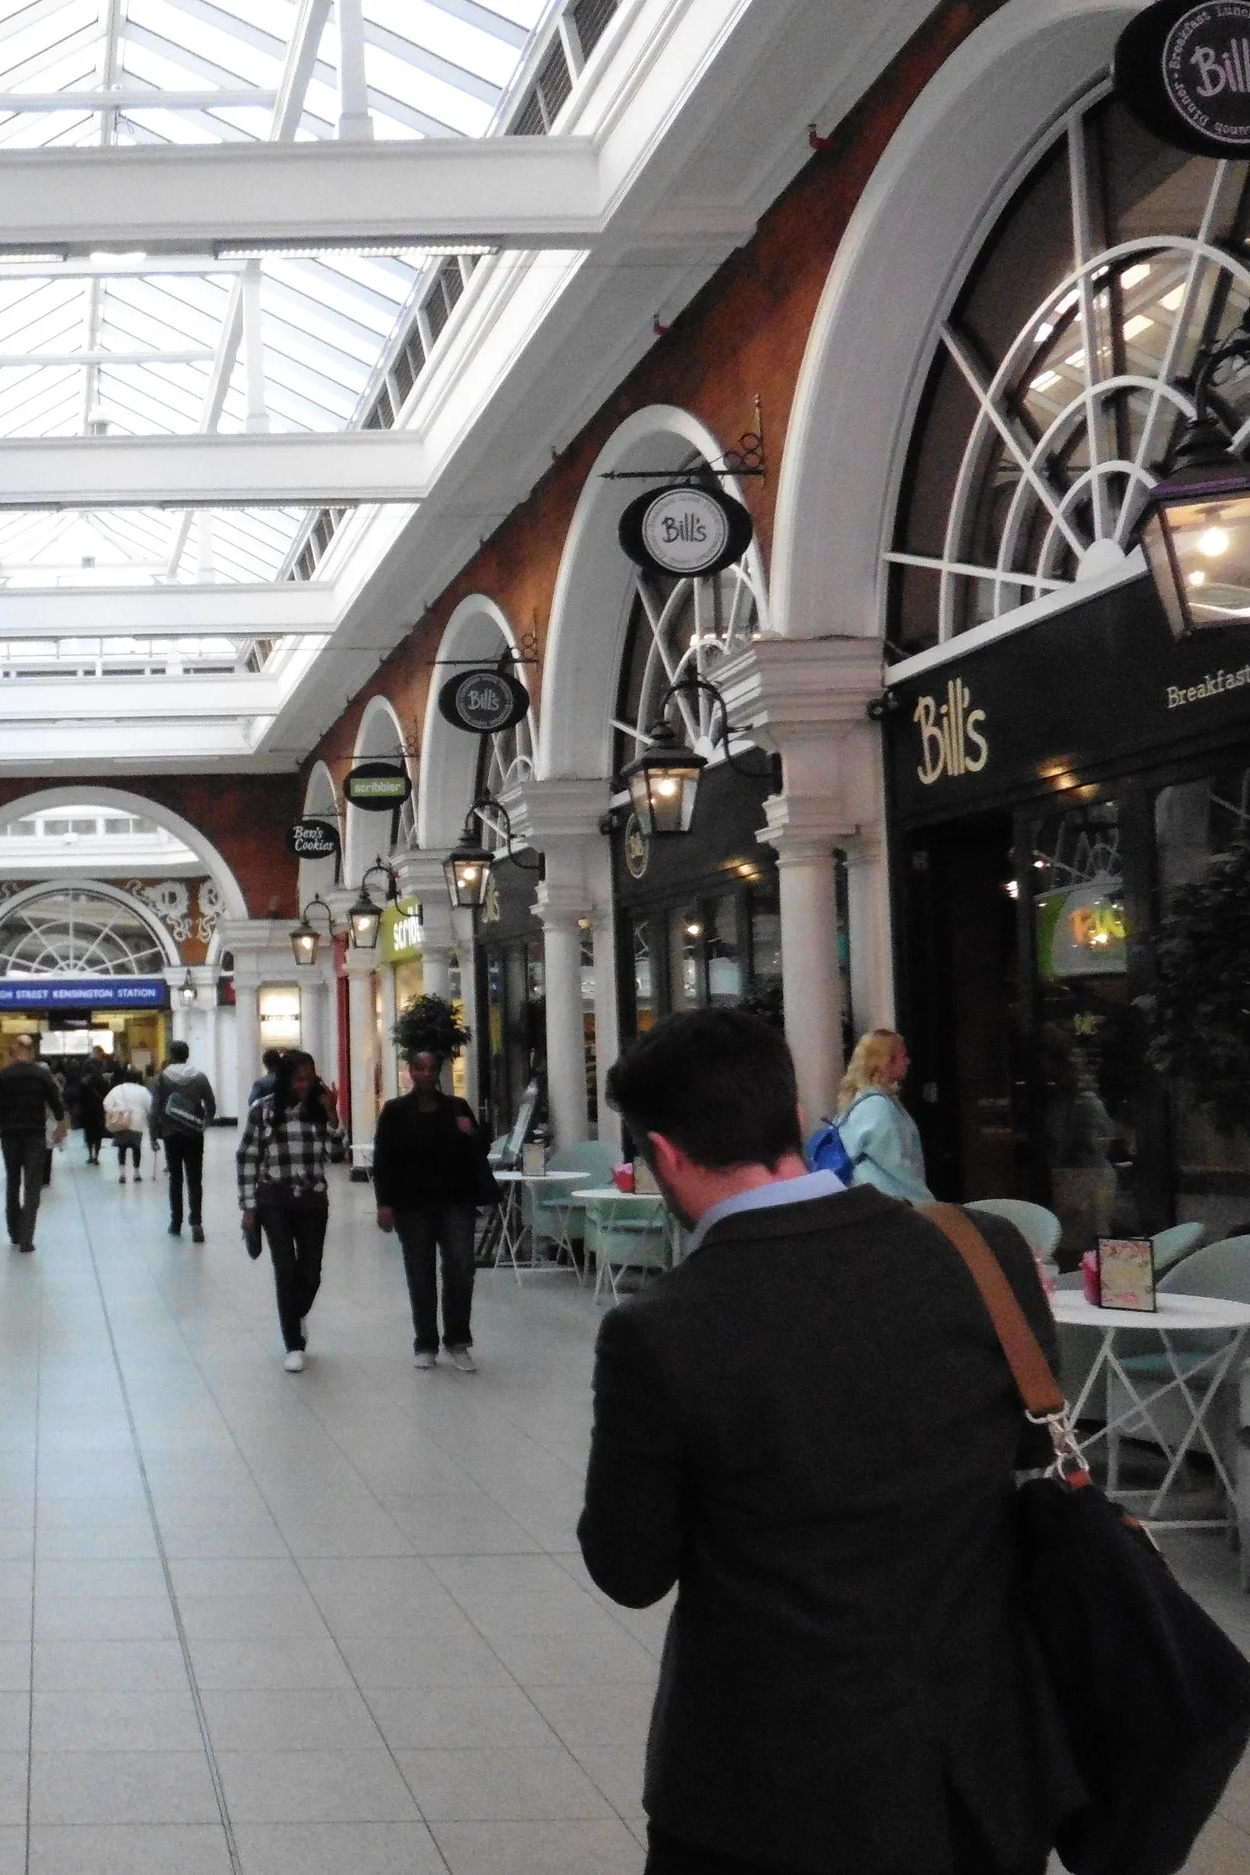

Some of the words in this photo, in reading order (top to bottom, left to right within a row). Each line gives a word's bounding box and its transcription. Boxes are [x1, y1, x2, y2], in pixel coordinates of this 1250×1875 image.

[1190, 38, 1250, 97] Bill
[661, 512, 707, 543] Bill's
[468, 687, 500, 711] Bill's
[913, 677, 989, 785] Bill's
[354, 781, 401, 793] scribbler
[292, 825, 323, 839] Ben's
[294, 837, 334, 851] Cookies
[15, 989, 50, 999] STREET
[52, 988, 113, 999] KENSINGTON
[117, 988, 156, 998] STATION
